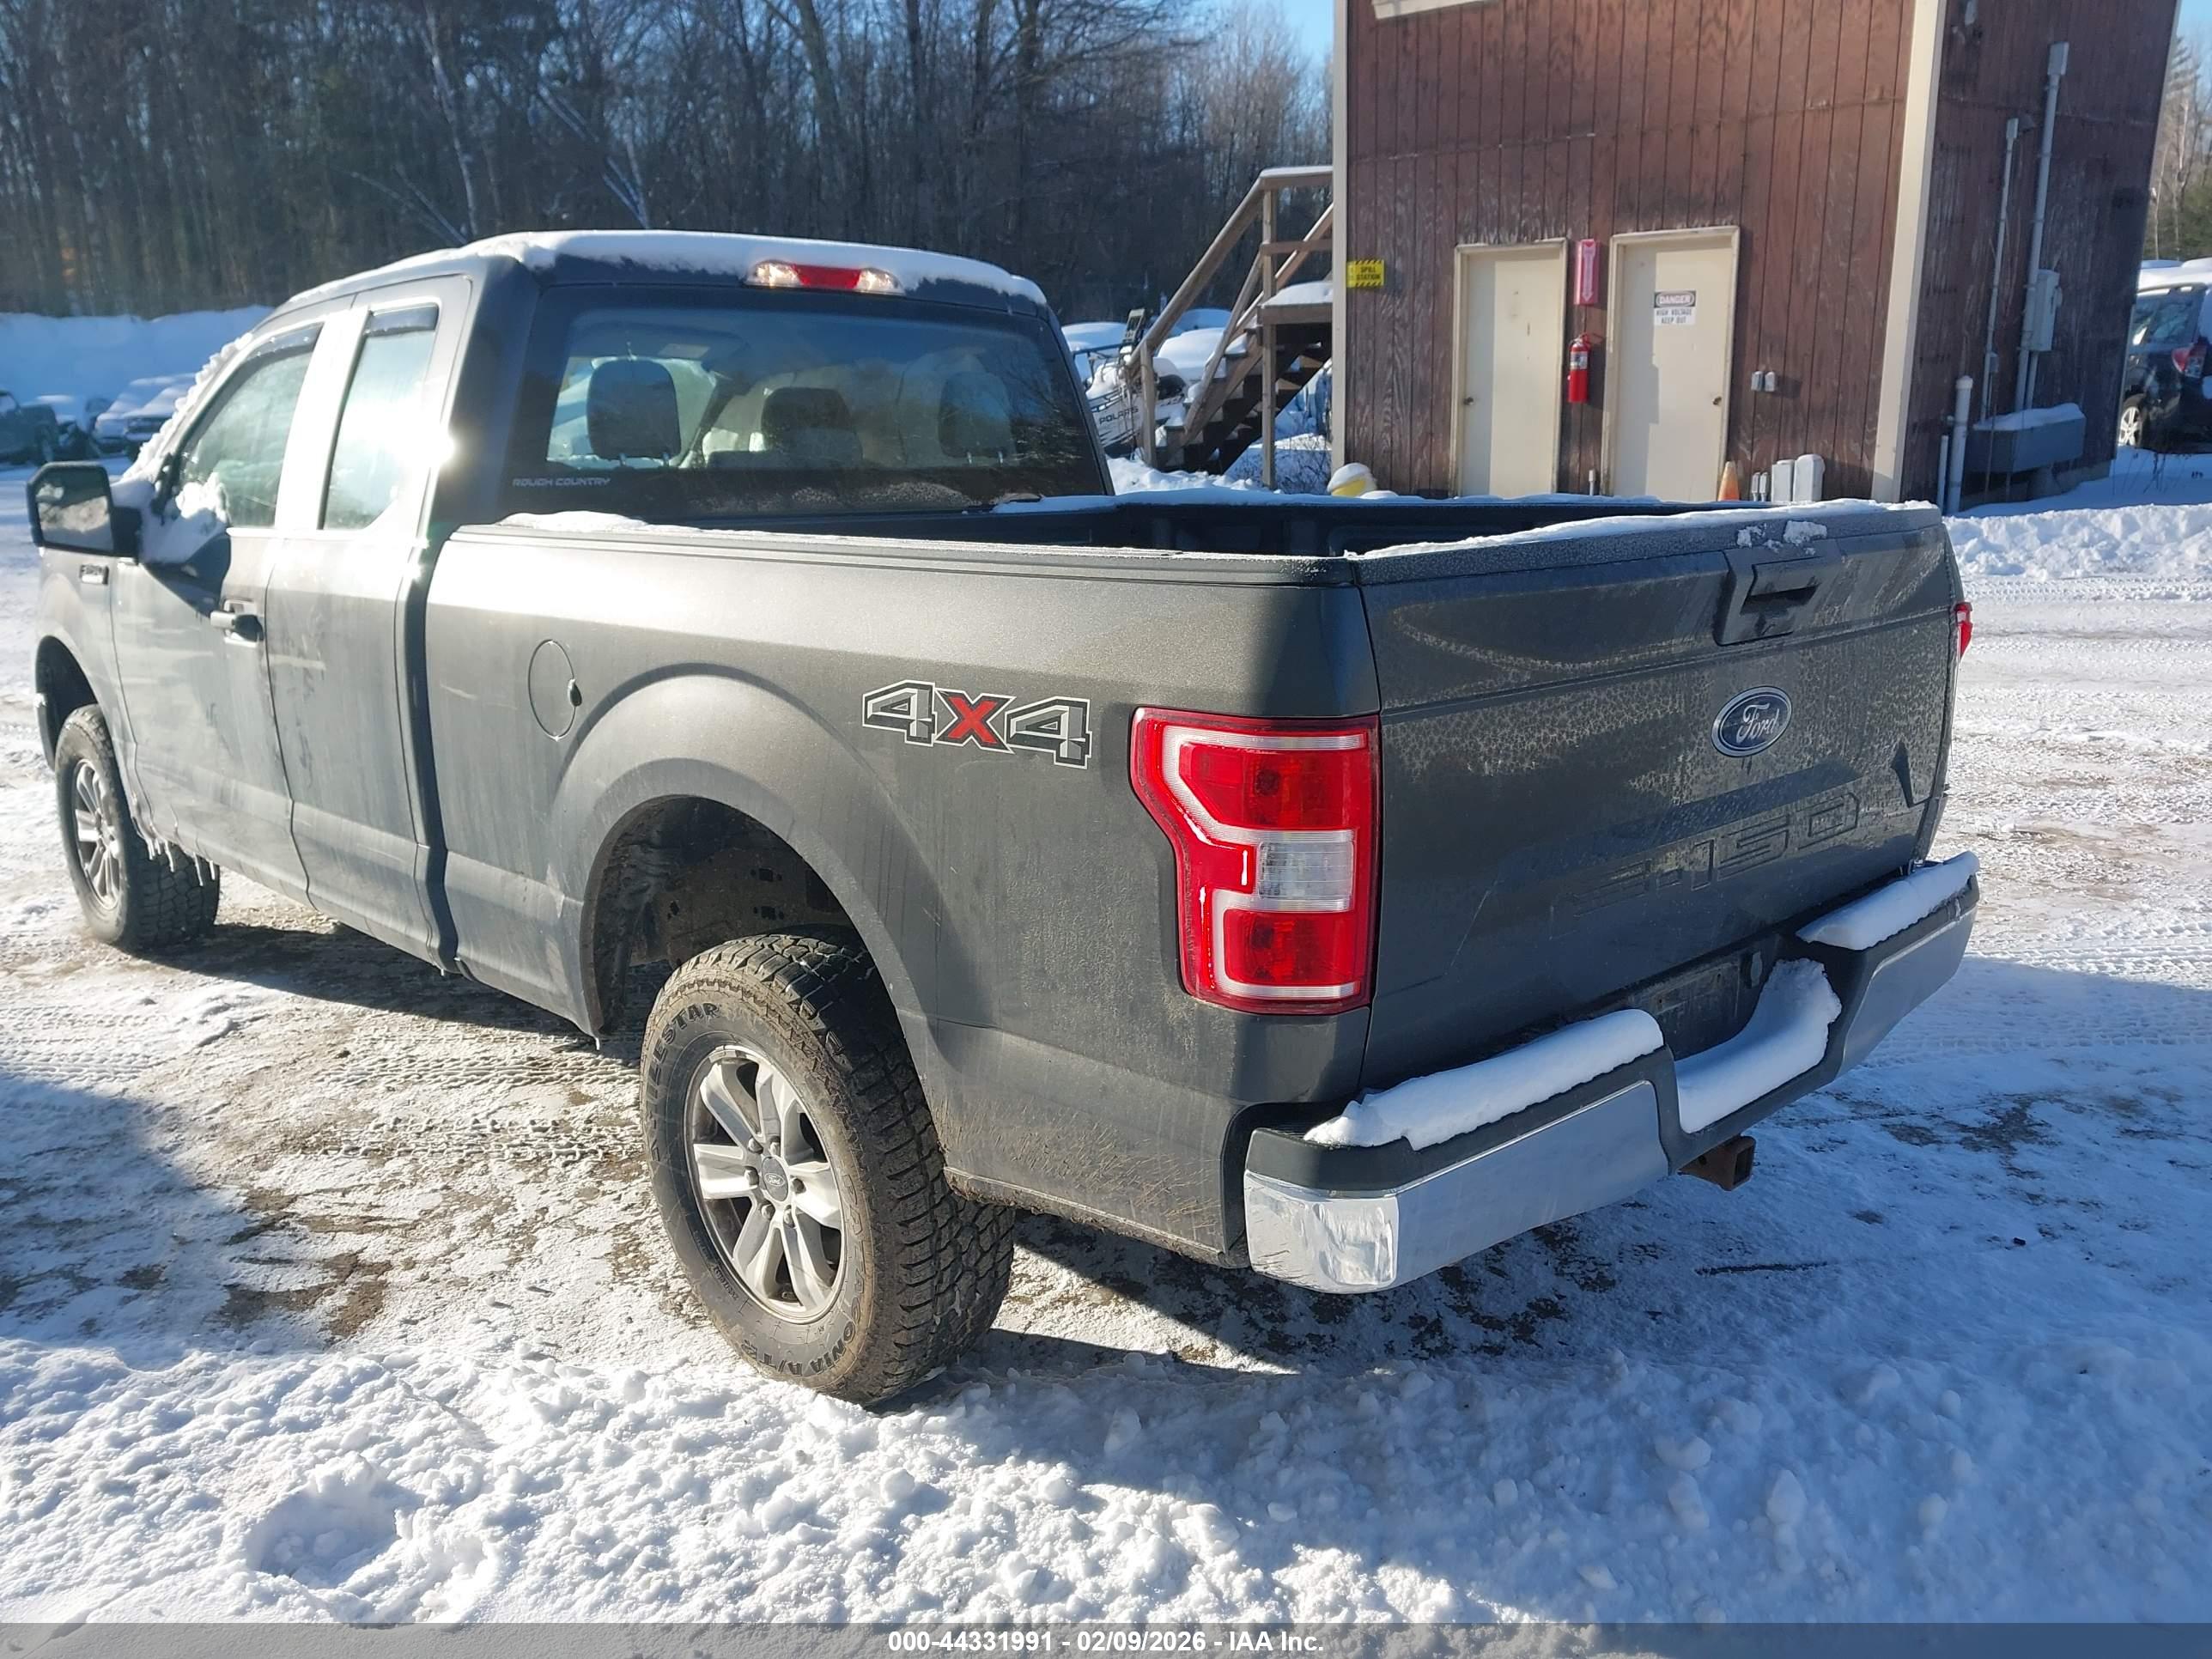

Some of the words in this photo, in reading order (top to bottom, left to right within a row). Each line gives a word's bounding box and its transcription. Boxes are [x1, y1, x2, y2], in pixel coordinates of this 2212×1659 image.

[1659, 295, 1691, 304] DANGER
[1676, 315, 1686, 324] OUT
[512, 477, 552, 488] ROUGH
[555, 477, 611, 487] COUNTRY
